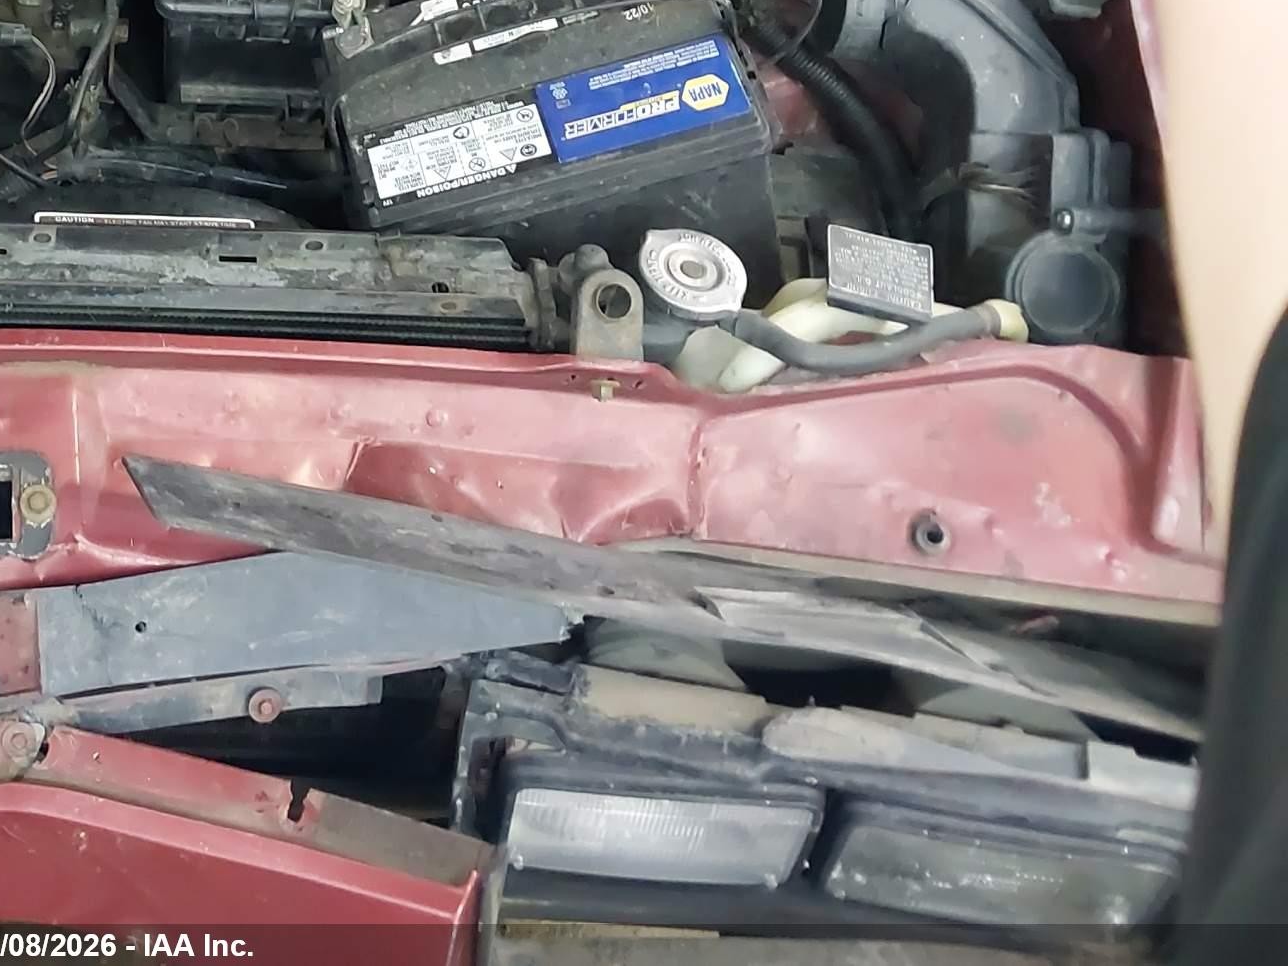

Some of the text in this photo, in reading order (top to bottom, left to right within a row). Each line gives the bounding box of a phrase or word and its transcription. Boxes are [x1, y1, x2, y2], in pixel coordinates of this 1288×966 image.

[623, 1, 655, 21] 10/22
[688, 81, 723, 103] NAPA
[564, 94, 681, 140] PROFORMER
[416, 169, 507, 199] DANGER/POISON
[55, 216, 95, 224] CAUTION
